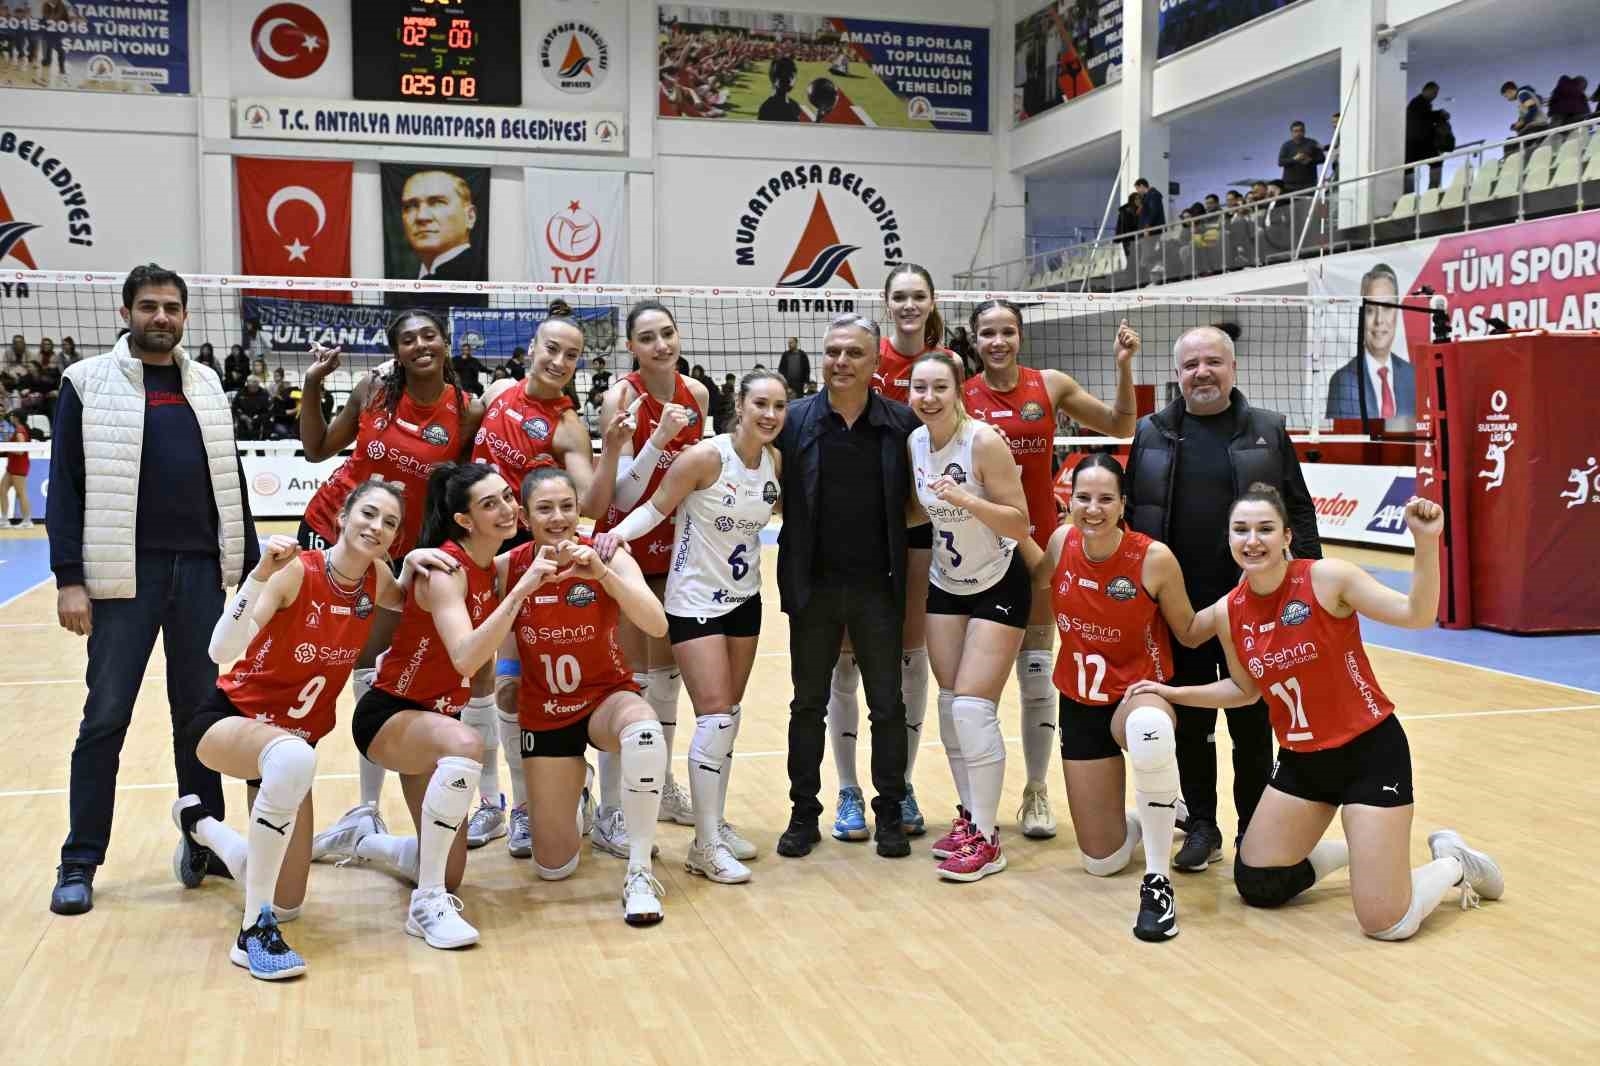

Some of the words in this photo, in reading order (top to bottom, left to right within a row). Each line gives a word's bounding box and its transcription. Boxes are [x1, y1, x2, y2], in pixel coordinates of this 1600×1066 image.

[74, 4, 169, 22] TAKIMIMIZ
[94, 20, 169, 40] TÜRKİYE
[448, 29, 472, 48] 00
[62, 38, 169, 57] ŞAMPİYONU
[840, 31, 903, 47] AMATÖR
[906, 36, 973, 52] SPORLAR
[886, 50, 973, 67] TOPLUMSAL
[872, 64, 973, 82] MUTLULUĞUN
[896, 80, 973, 97] TEMELİDİR
[279, 109, 309, 131] T.C.
[315, 110, 390, 134] ANTALYA
[500, 117, 587, 143] BELEDİYESİ
[736, 164, 823, 267] MURATPAŞA
[550, 266, 598, 285] TVF
[1442, 247, 1505, 295] TÜM
[1509, 240, 1600, 287] SPOR
[777, 299, 855, 314] ANTALYA
[308, 531, 326, 550] 16
[940, 530, 962, 568] 3
[728, 544, 749, 581] 6
[540, 653, 582, 695] 10
[1073, 651, 1110, 703] 12
[288, 675, 327, 720] 9
[521, 731, 536, 752] 10
